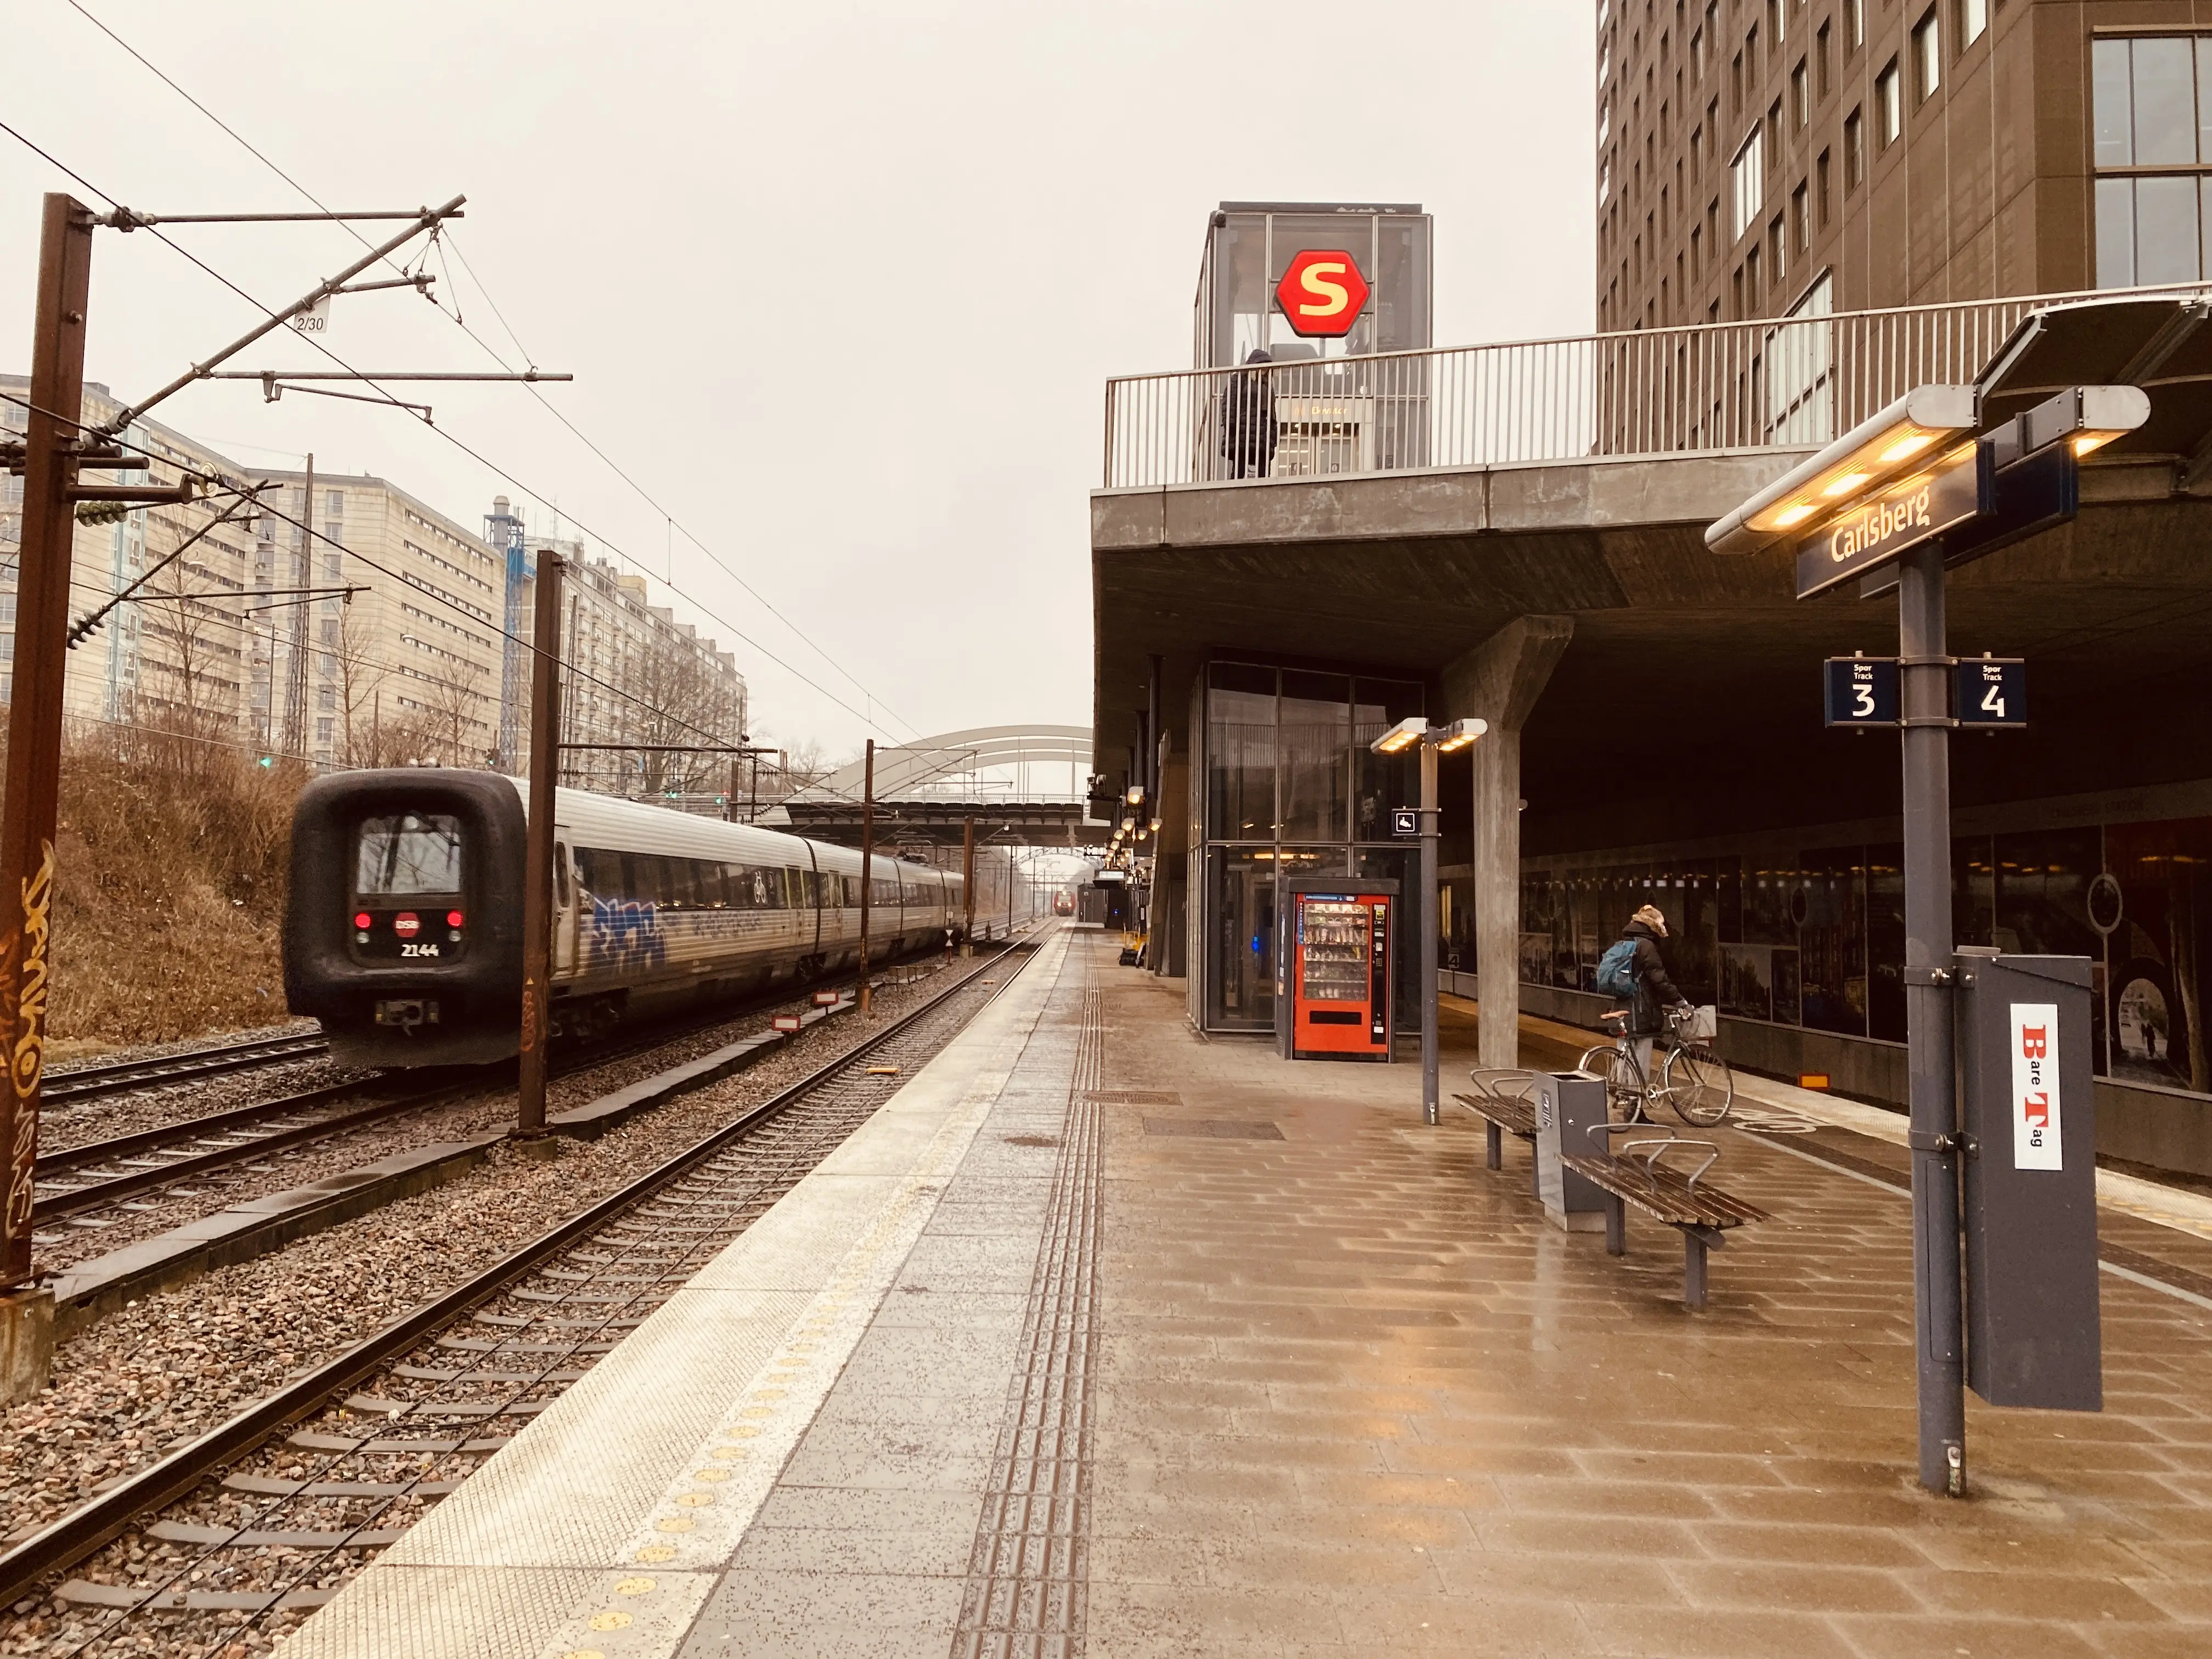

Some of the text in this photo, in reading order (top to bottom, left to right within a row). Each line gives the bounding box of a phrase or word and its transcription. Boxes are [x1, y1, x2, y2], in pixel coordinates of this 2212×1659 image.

[1300, 262, 1348, 316] S
[297, 317, 323, 331] 2/30
[1831, 486, 1931, 562] Carlsberg
[1854, 664, 1872, 673] Spor
[1983, 665, 2002, 674] Spor
[1852, 684, 1875, 716] 3
[1981, 685, 2005, 717] 4
[400, 944, 439, 957] 2144
[2023, 1024, 2049, 1148] Bare Tag
